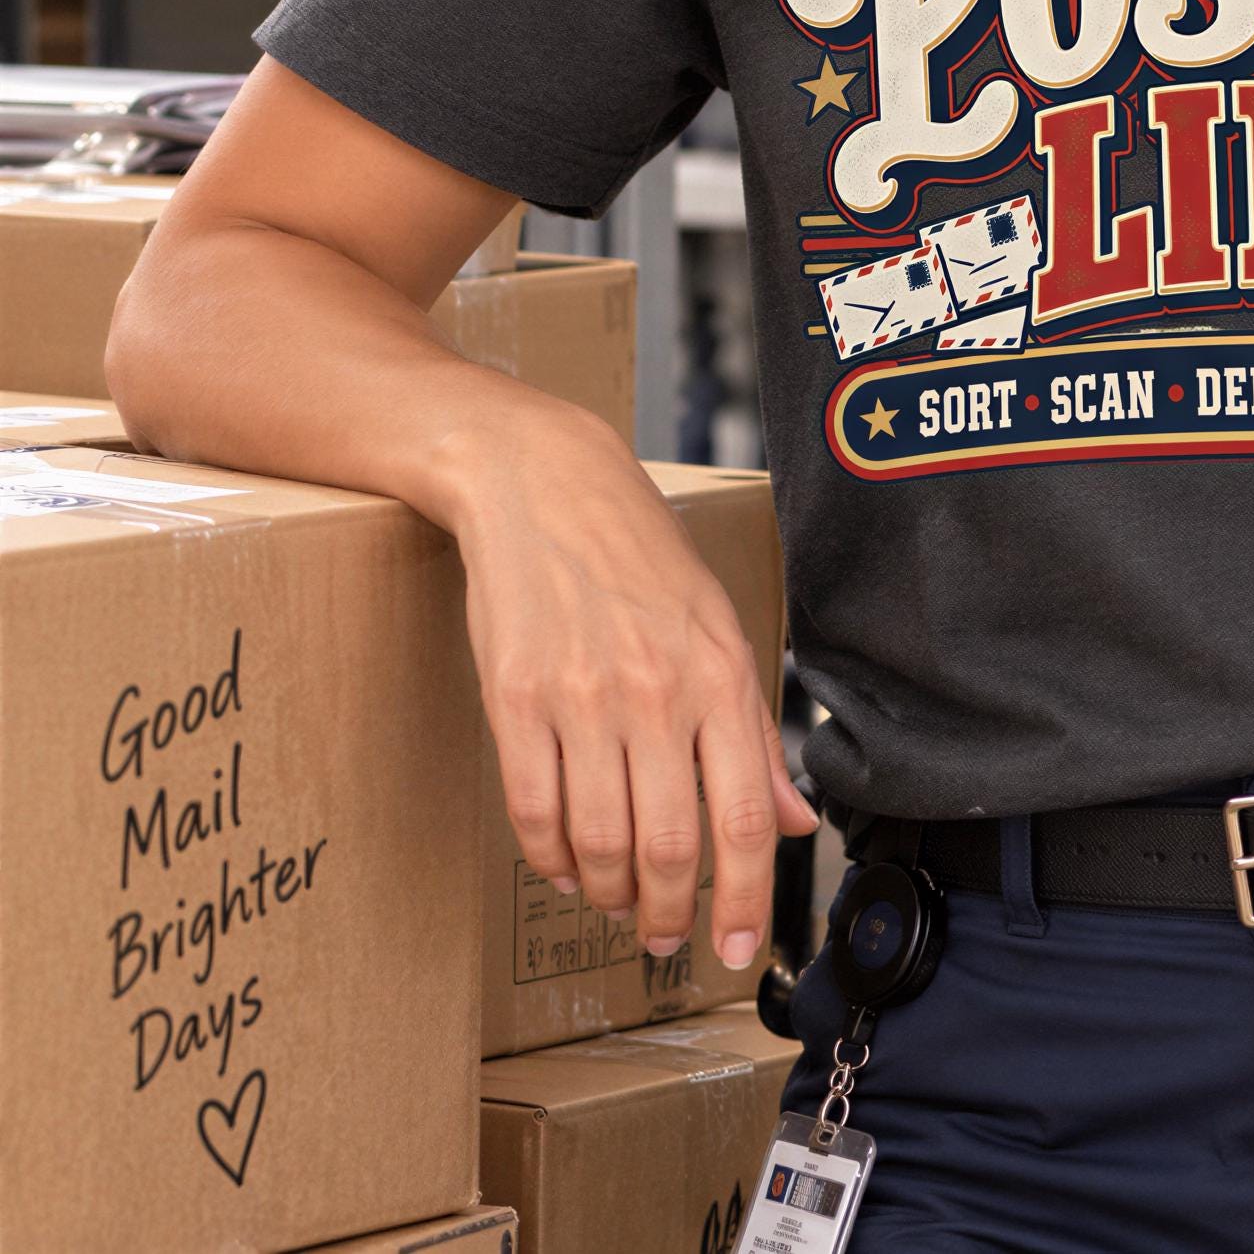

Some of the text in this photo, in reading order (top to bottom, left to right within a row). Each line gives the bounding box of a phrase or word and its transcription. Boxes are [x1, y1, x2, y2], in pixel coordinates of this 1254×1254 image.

[918, 379, 1018, 439] SORT
[1050, 370, 1156, 425] SCAN
[100, 627, 244, 784] Good
[120, 741, 244, 891] Mail
[108, 838, 329, 1000] Brighter
[130, 975, 264, 1092] Days
